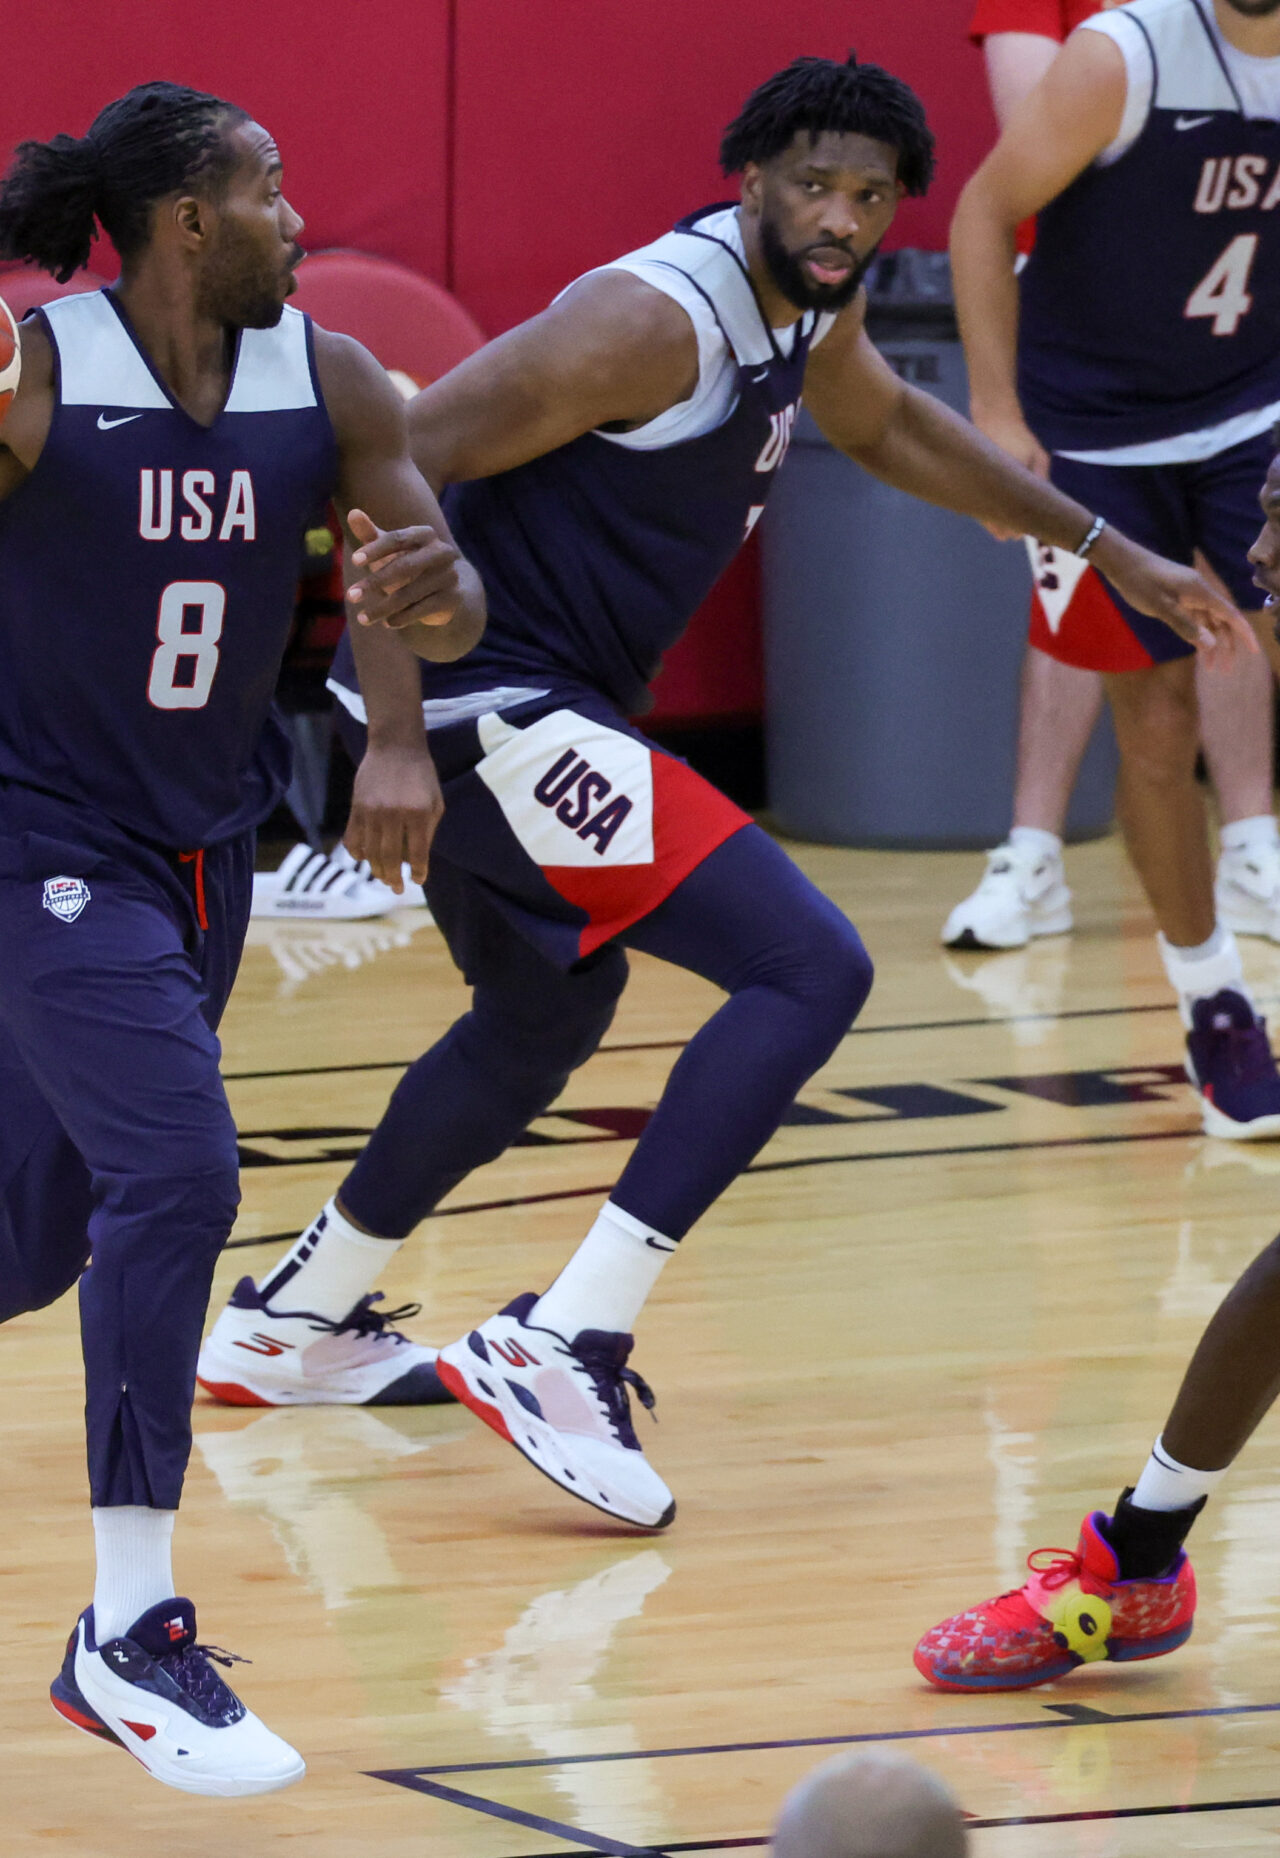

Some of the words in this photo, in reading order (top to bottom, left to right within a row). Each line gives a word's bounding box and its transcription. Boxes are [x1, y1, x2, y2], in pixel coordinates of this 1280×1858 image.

[1183, 232, 1259, 337] 4
[138, 468, 256, 541] USA
[146, 579, 227, 711] 8
[534, 747, 633, 856] USA
